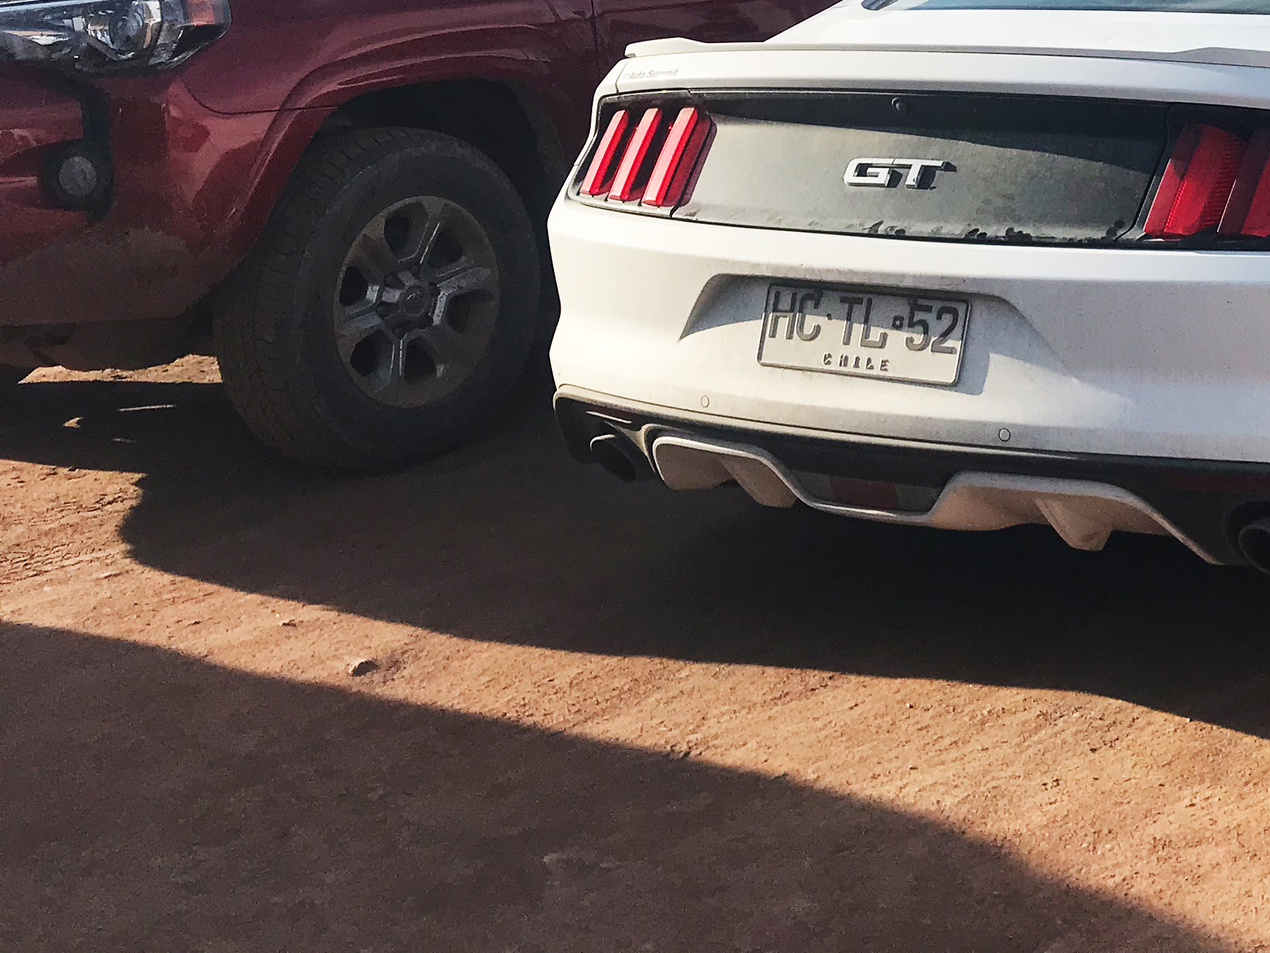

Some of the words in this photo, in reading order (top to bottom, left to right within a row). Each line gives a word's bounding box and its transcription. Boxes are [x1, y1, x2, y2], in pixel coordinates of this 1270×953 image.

[628, 70, 646, 80] Auto
[647, 68, 679, 78] Summit
[843, 157, 947, 189] GT
[823, 352, 890, 372] CHILE
